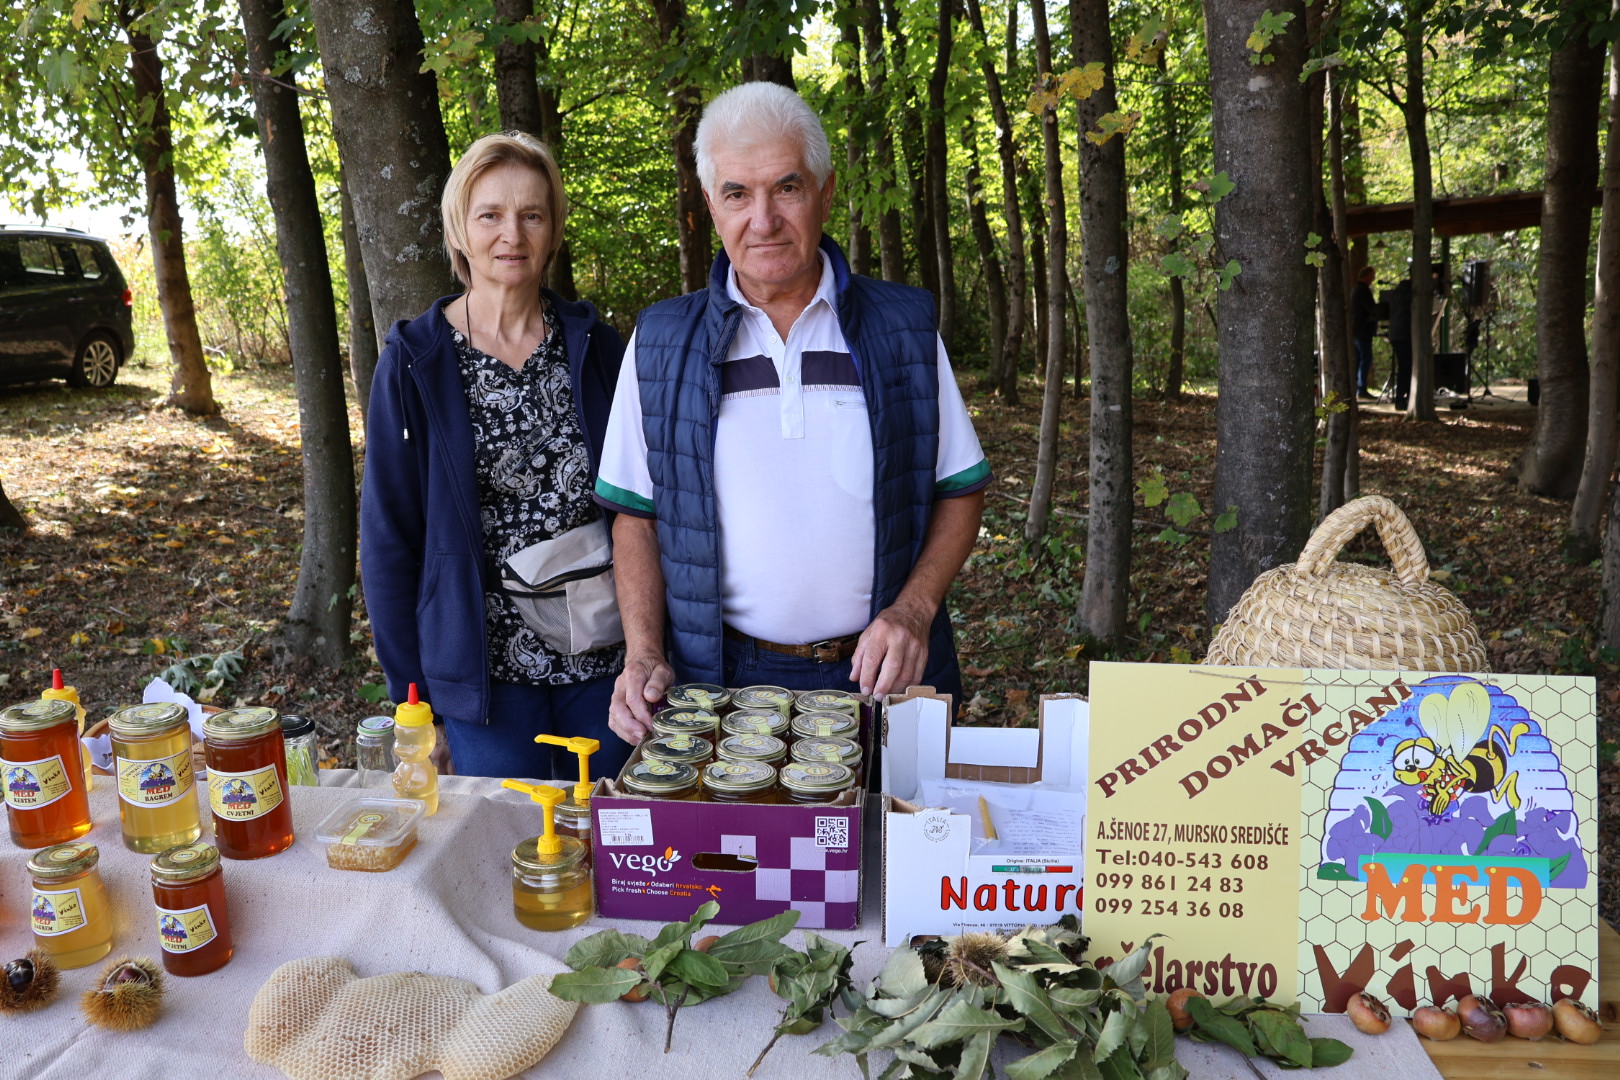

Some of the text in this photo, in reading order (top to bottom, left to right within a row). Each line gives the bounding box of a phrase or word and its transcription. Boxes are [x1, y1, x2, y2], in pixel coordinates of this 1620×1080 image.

[1095, 674, 1267, 799] PRIRODNI
[1270, 677, 1413, 777] VRCANI
[1178, 693, 1323, 799] DOMAČI
[13, 789, 35, 798] MED
[144, 792, 173, 802] BAGREM
[145, 784, 171, 795] MED
[226, 809, 254, 817] CVJETNI
[227, 801, 252, 810] MED
[1097, 817, 1150, 841] A.ŠENOE
[1152, 823, 1172, 845] 27,
[1174, 824, 1228, 843] MURSKO
[1230, 822, 1289, 846] SREDIŠĆE
[609, 850, 675, 878] vego
[1096, 849, 1269, 871] Tel:040-543 608
[611, 878, 626, 886] Biraj
[675, 882, 703, 890] hrvatsko
[669, 889, 692, 897] Croatia
[1096, 873, 1244, 893] 099 861 24 83
[1360, 862, 1543, 926] MED
[1095, 898, 1244, 919] 099 254 36 08
